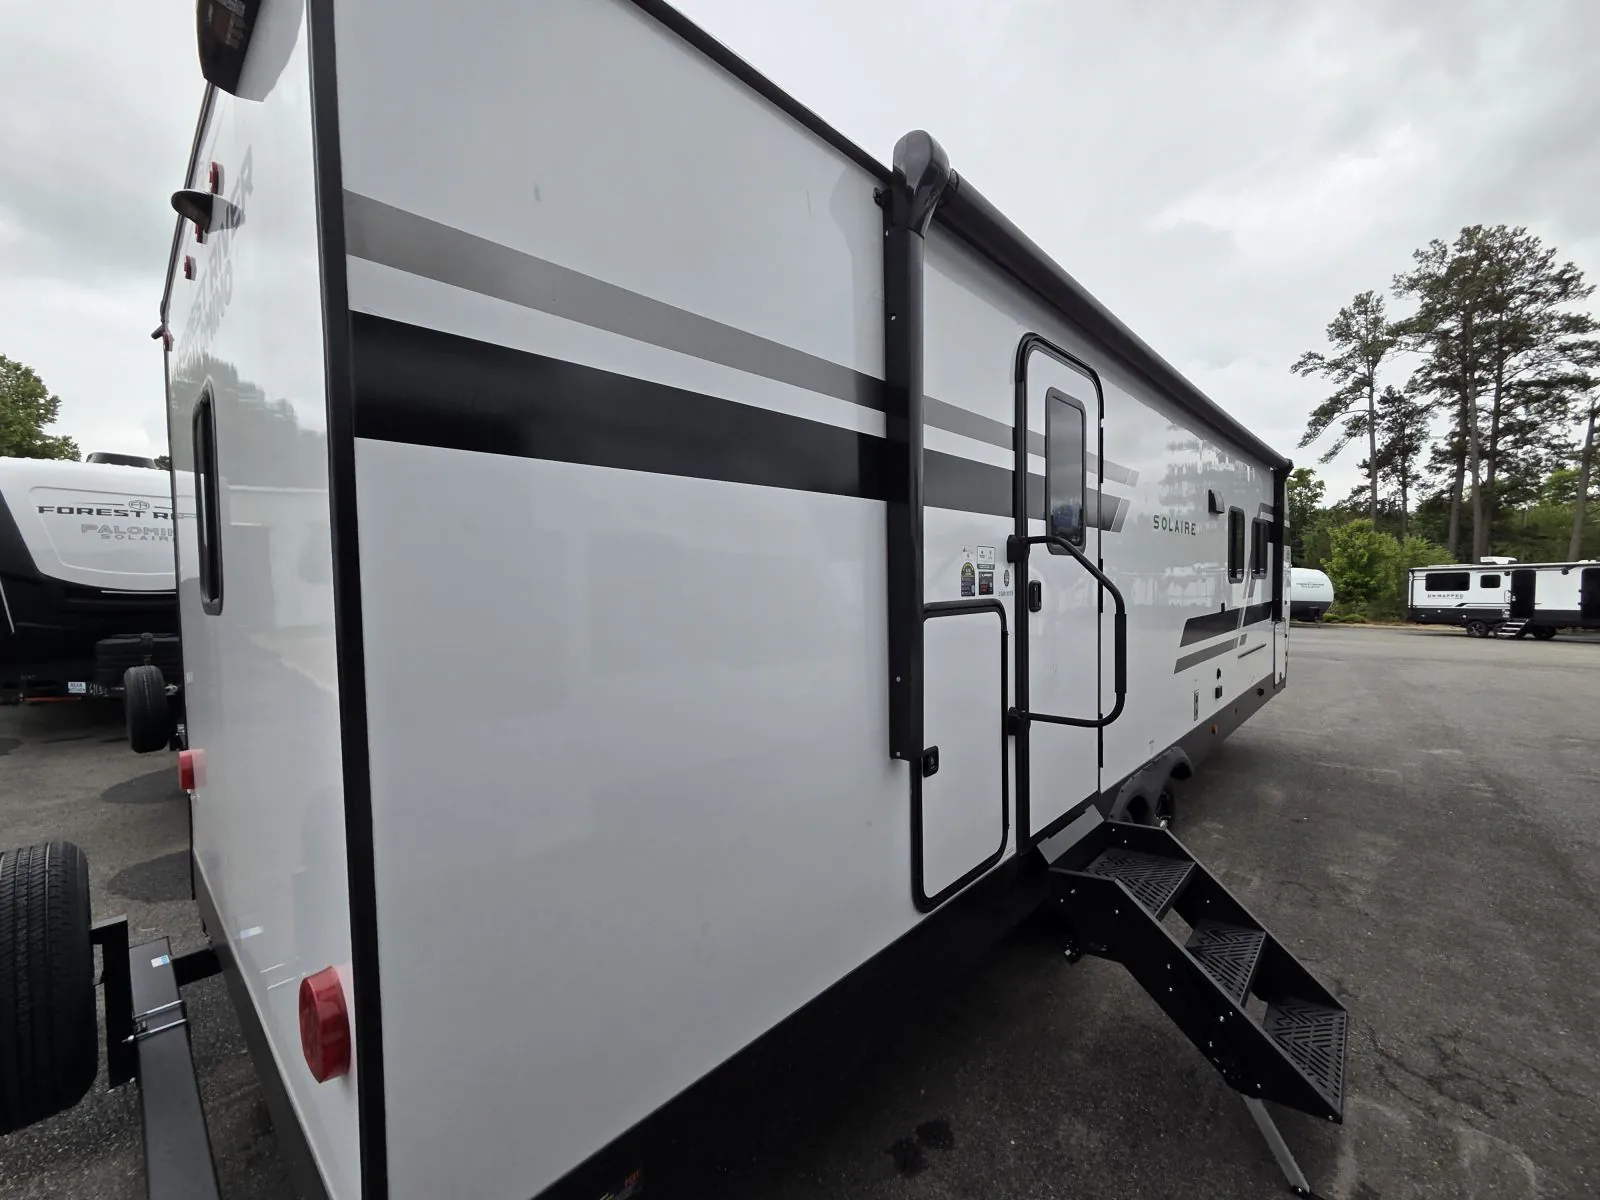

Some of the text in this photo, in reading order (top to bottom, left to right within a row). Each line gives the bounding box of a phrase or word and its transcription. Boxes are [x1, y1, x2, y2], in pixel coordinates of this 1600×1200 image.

[37, 506, 146, 518] FOREST
[1153, 514, 1197, 536] SOLAIRE
[101, 533, 173, 542] SOLAIR
